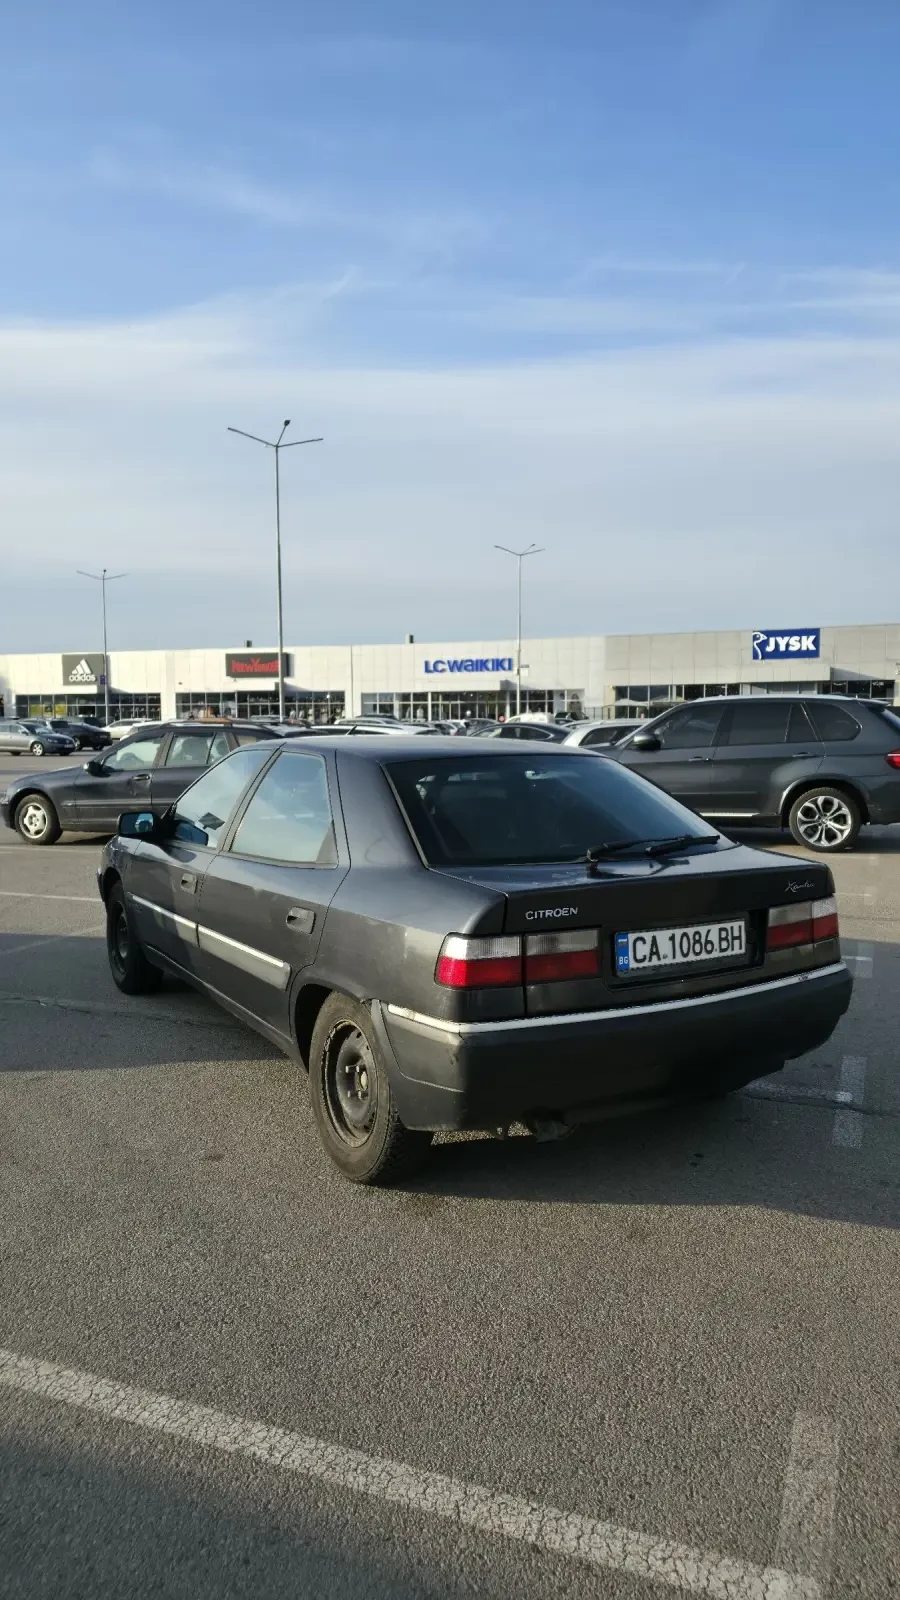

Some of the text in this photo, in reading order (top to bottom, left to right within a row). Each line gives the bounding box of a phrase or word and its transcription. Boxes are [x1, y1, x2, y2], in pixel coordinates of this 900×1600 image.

[765, 635, 817, 652] JYSK
[69, 673, 96, 682] adidas
[525, 905, 579, 920] CITROËN
[619, 955, 629, 965] BG
